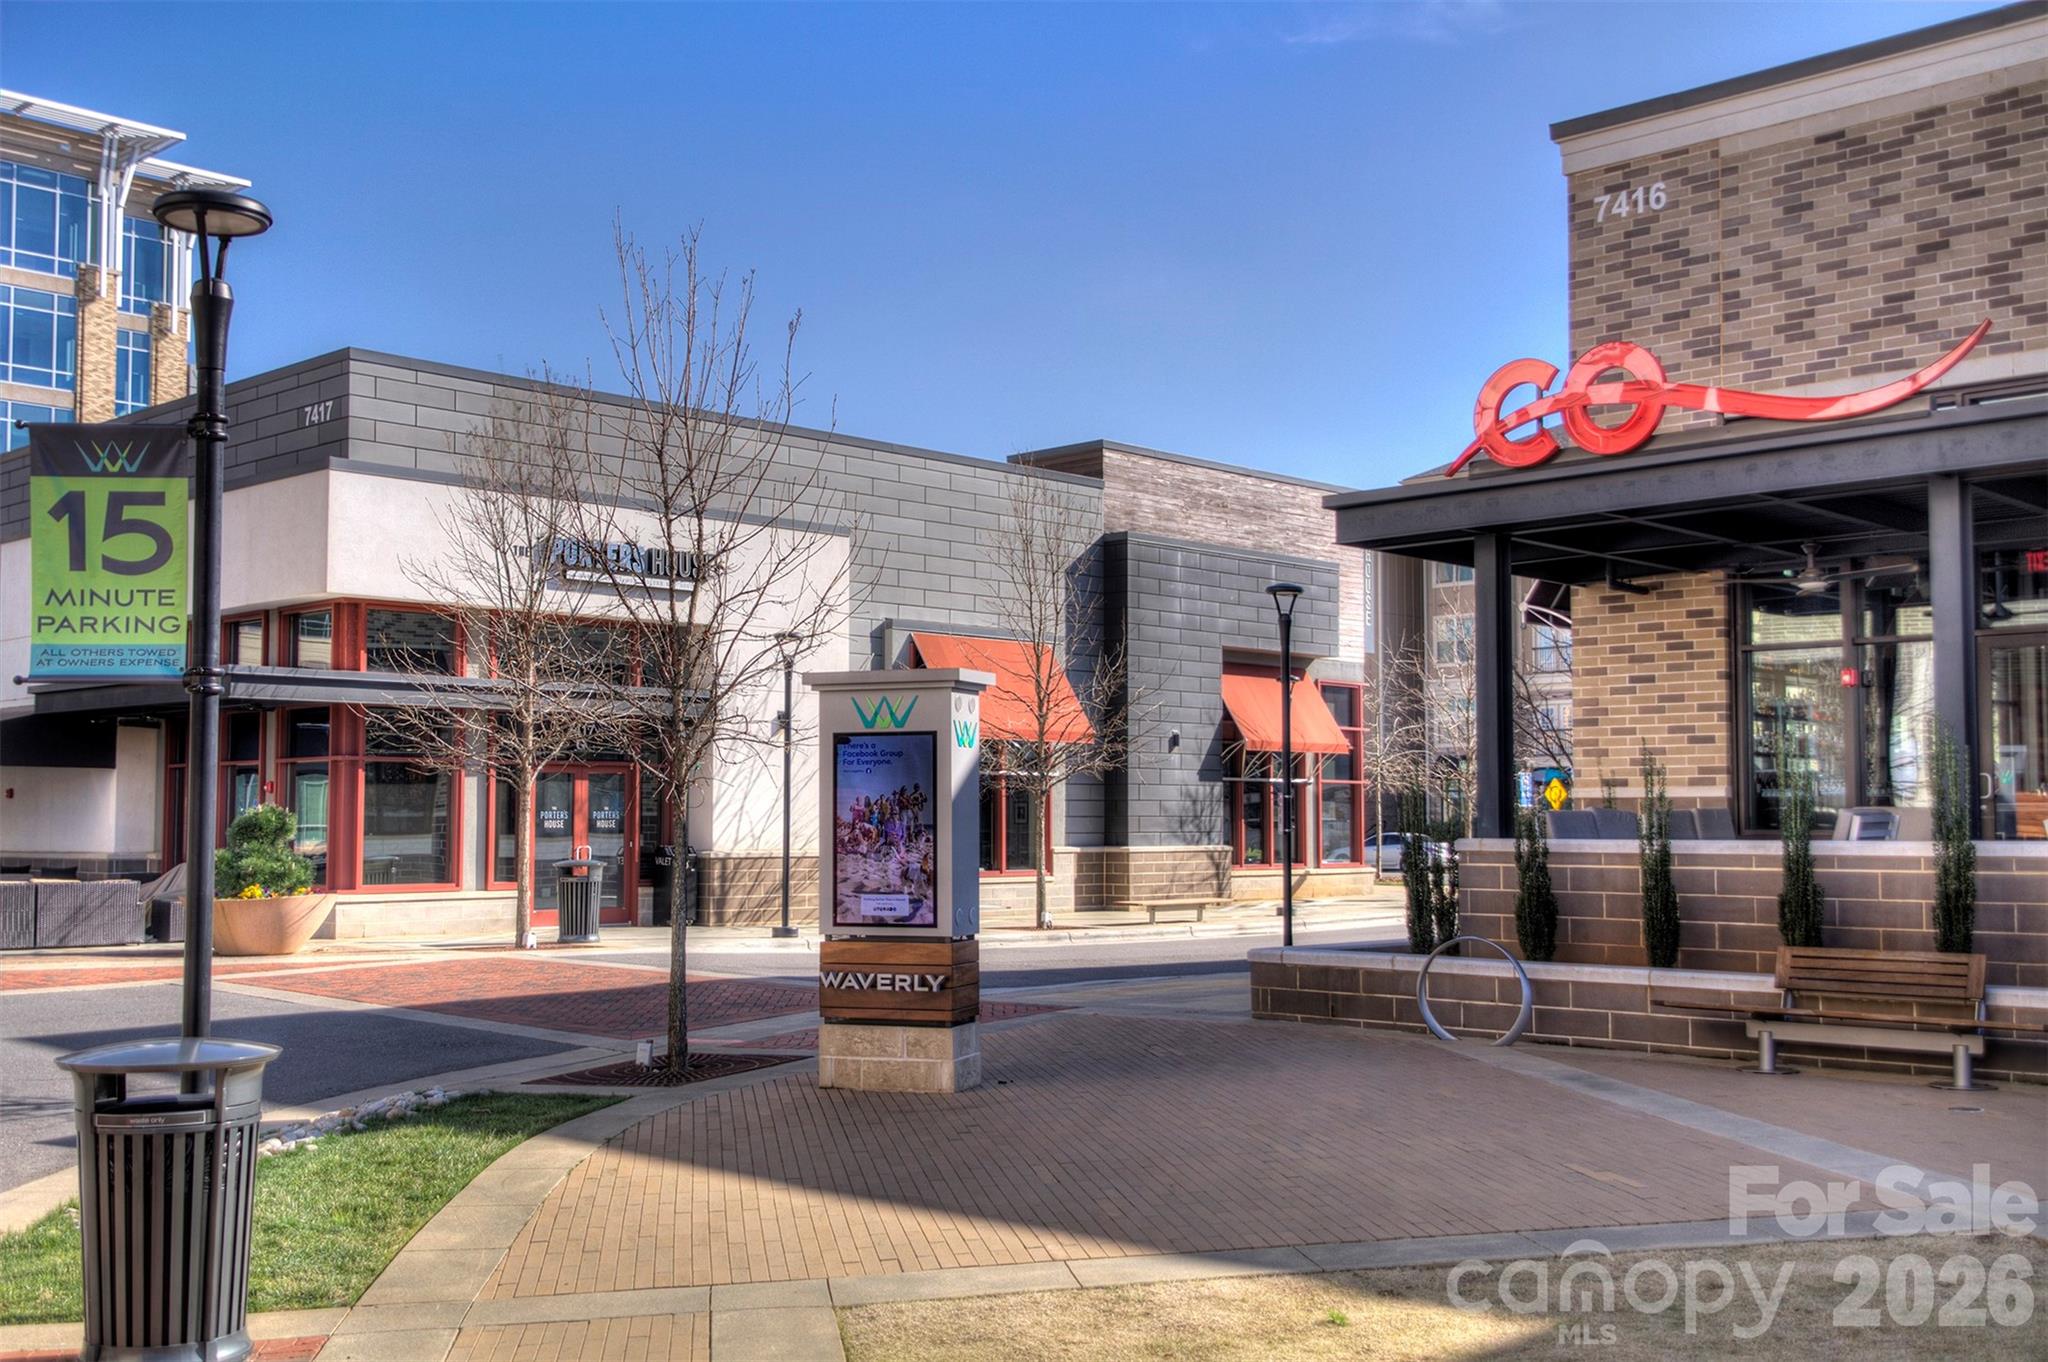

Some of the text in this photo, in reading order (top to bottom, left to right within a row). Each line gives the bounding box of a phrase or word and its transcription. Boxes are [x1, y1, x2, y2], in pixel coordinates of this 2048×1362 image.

[1594, 182, 1667, 223] 7416
[304, 400, 333, 427] 7417
[47, 490, 174, 576] 15
[651, 547, 715, 580] HOUS
[44, 588, 176, 607] MINUTE
[37, 615, 181, 634] PARKING
[40, 648, 177, 657] ALL OTHERS TOWED
[36, 658, 180, 668] AT OWNERS EXPENSE
[842, 750, 904, 758] Facebook Group
[544, 820, 565, 829] HOUSE
[596, 820, 616, 828] HOUSE
[655, 856, 672, 866] VALET
[820, 971, 945, 993] WAVERLY
